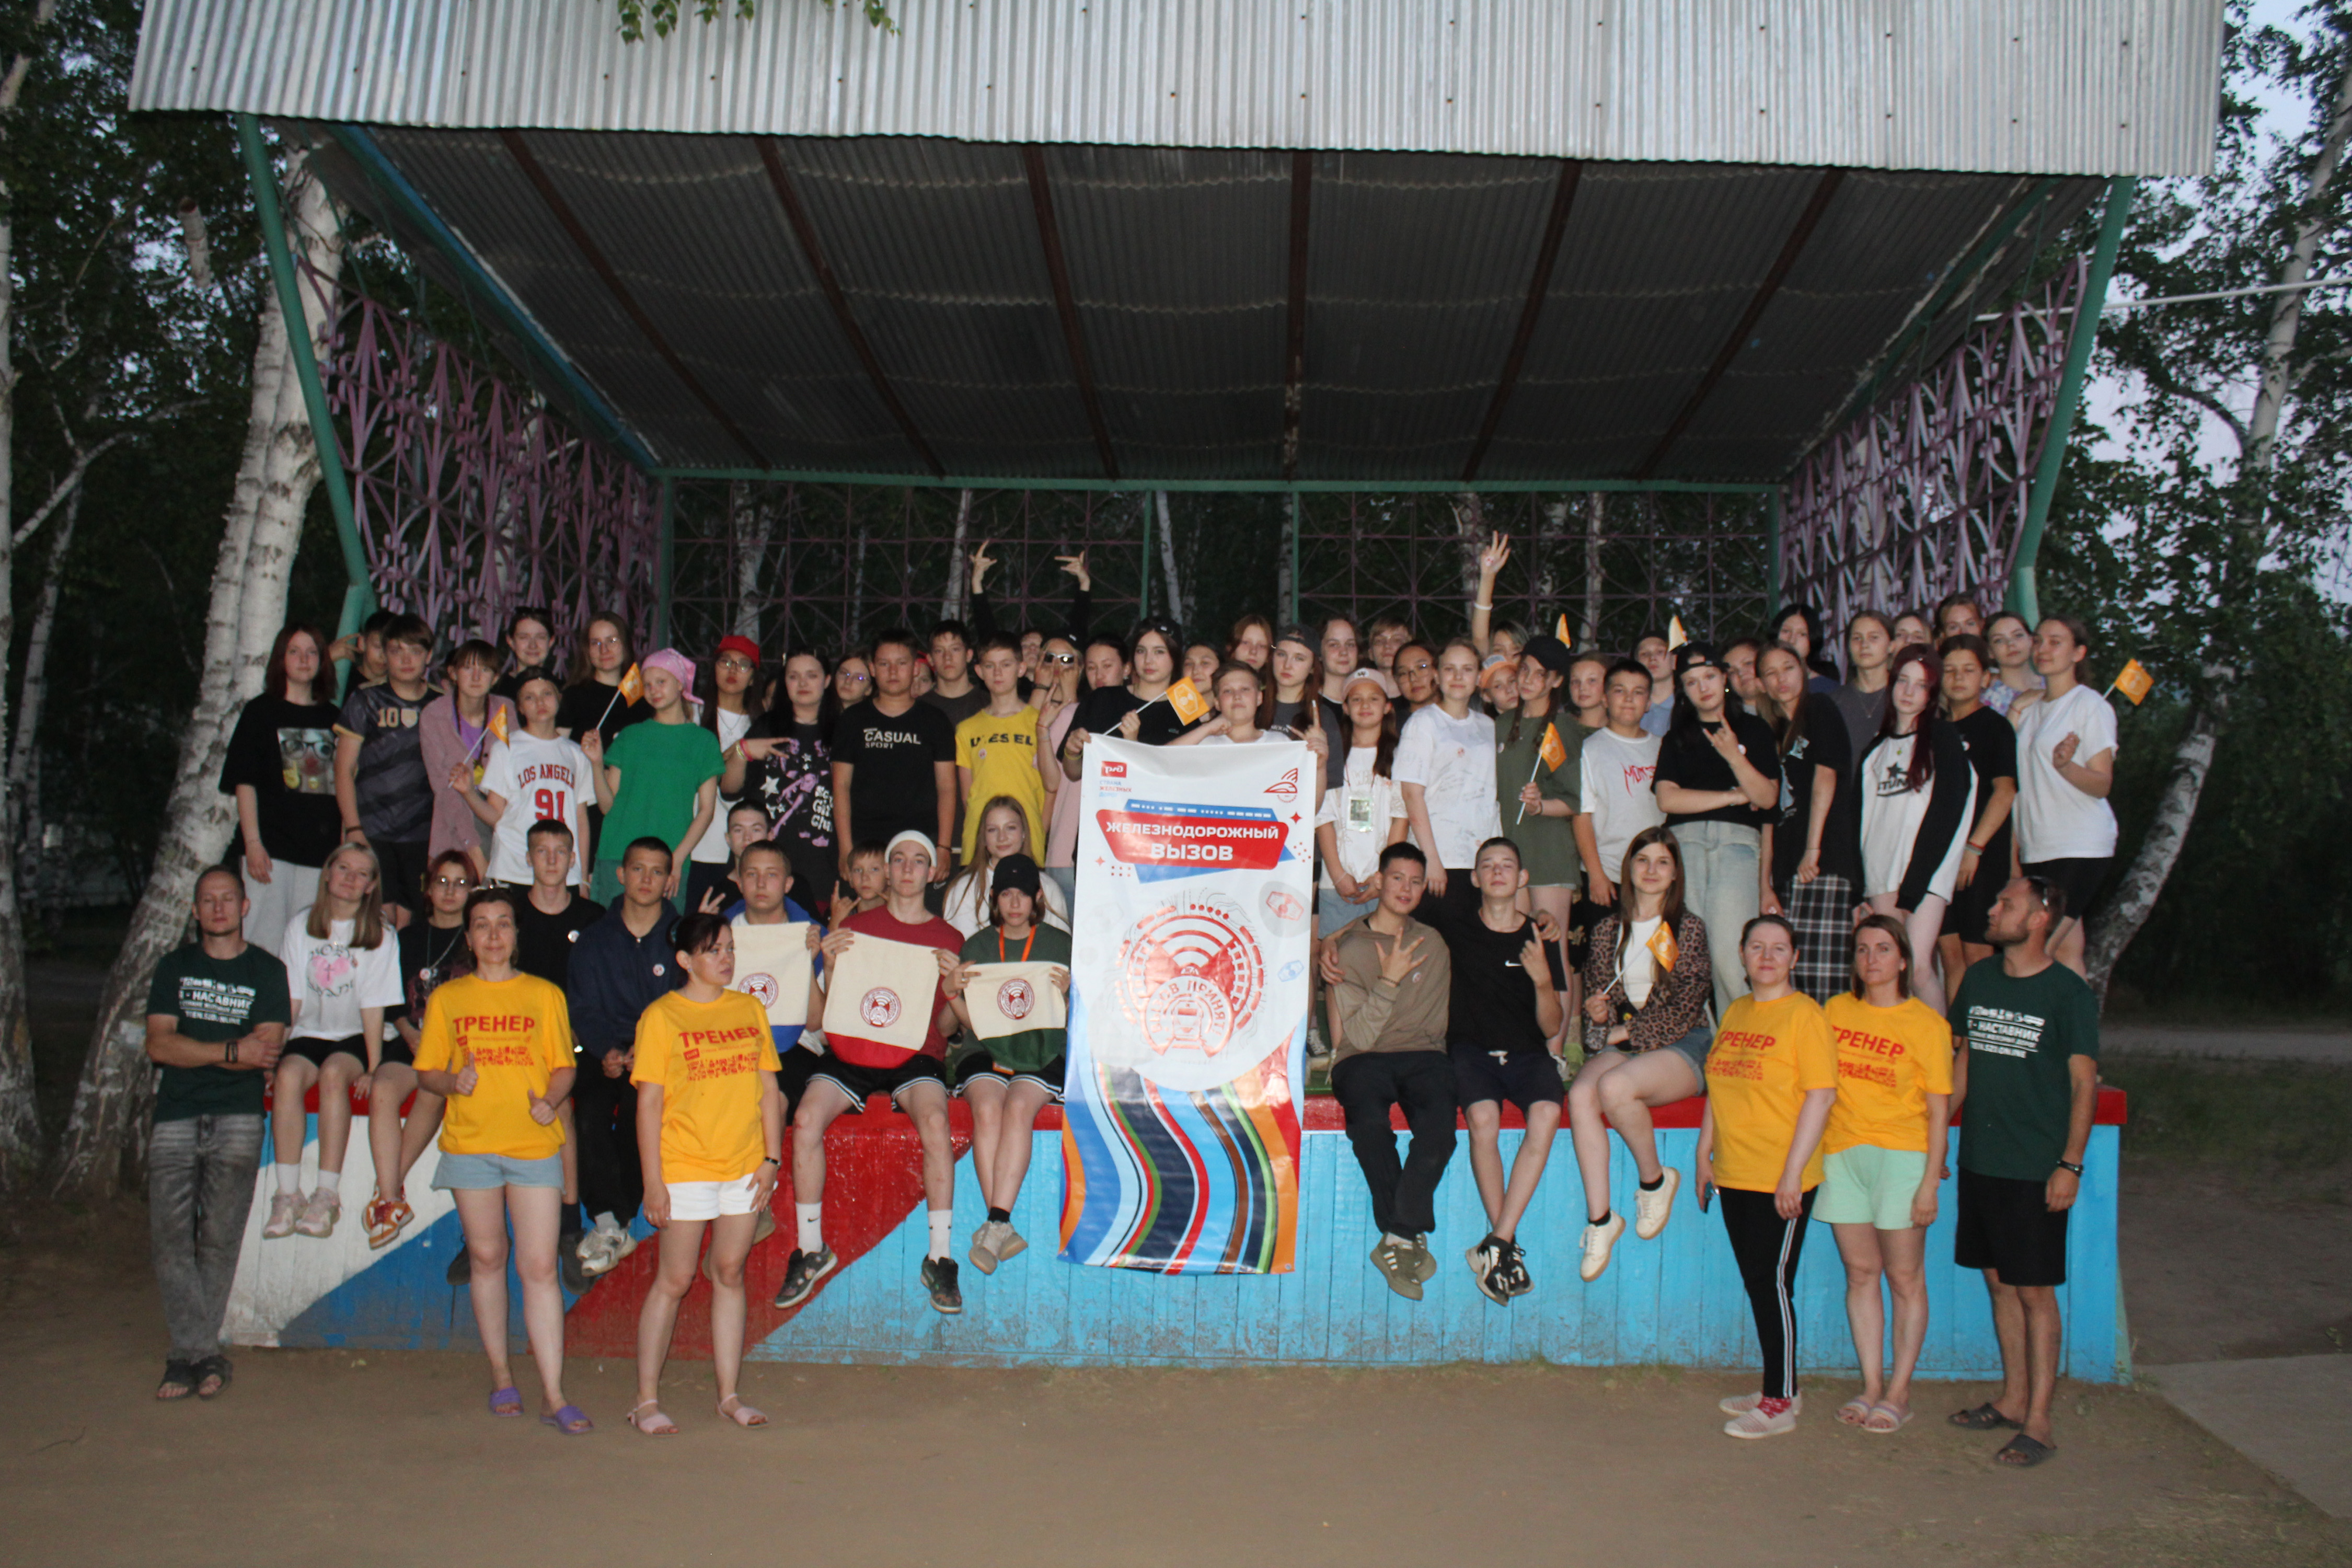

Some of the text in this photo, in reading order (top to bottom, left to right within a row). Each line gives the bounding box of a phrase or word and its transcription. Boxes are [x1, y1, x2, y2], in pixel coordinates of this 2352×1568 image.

[377, 708, 399, 728] 10
[864, 731, 921, 745] CASUAL
[518, 766, 536, 789] LOS
[535, 788, 565, 824] 91
[1106, 822, 1278, 839] ЖЕЛЕЗНОДОРОЖНЫЙ
[1150, 843, 1233, 861] ВЫЗОВ
[1150, 983, 1180, 1033] ВЫЗОВ
[453, 1016, 535, 1034] ТРЕНЕР
[1978, 1021, 2041, 1042] НАСТАВНИК
[679, 1027, 759, 1048] ТРЕНЕР
